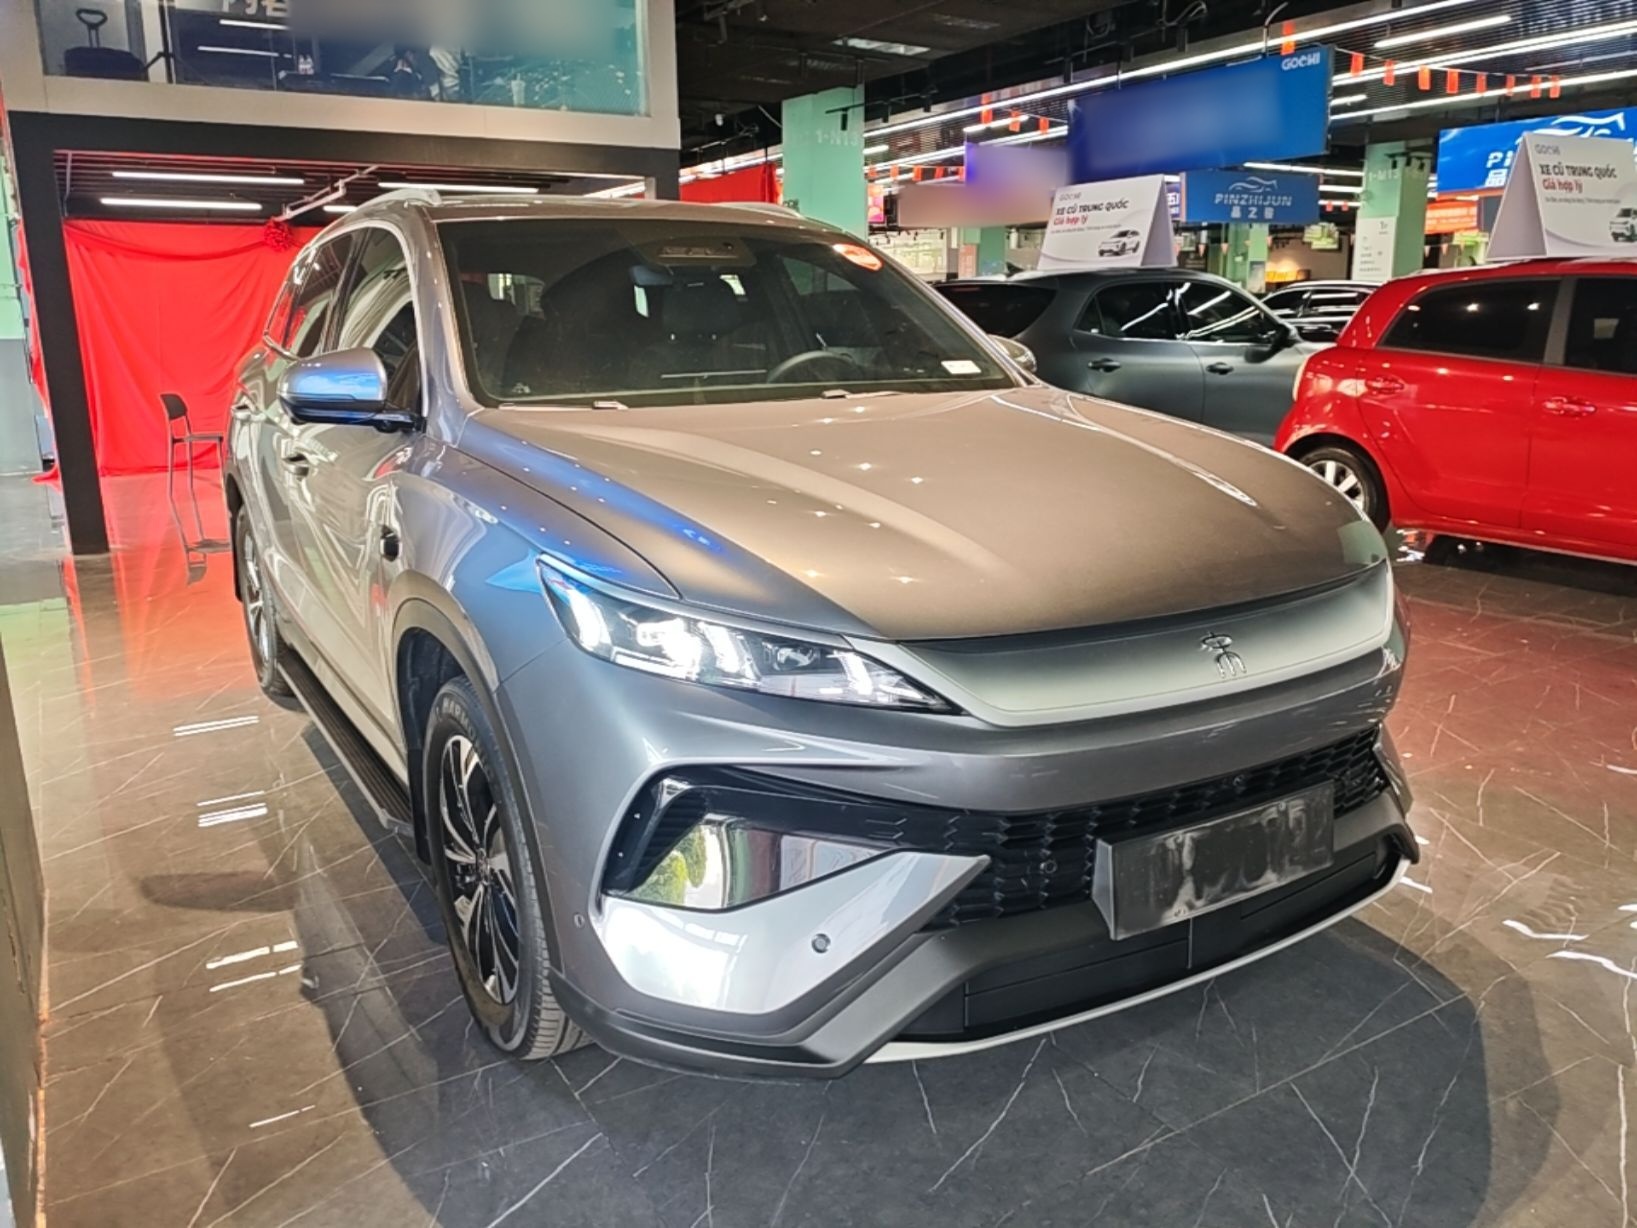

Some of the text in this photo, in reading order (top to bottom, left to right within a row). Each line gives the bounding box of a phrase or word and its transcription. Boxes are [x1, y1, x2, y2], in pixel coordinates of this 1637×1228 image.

[1281, 52, 1320, 71] GOCHI
[1486, 151, 1513, 168] PI
[1539, 164, 1551, 175] XE
[1565, 165, 1593, 177] TRUNG
[1215, 193, 1292, 206] PINZHIJUN
